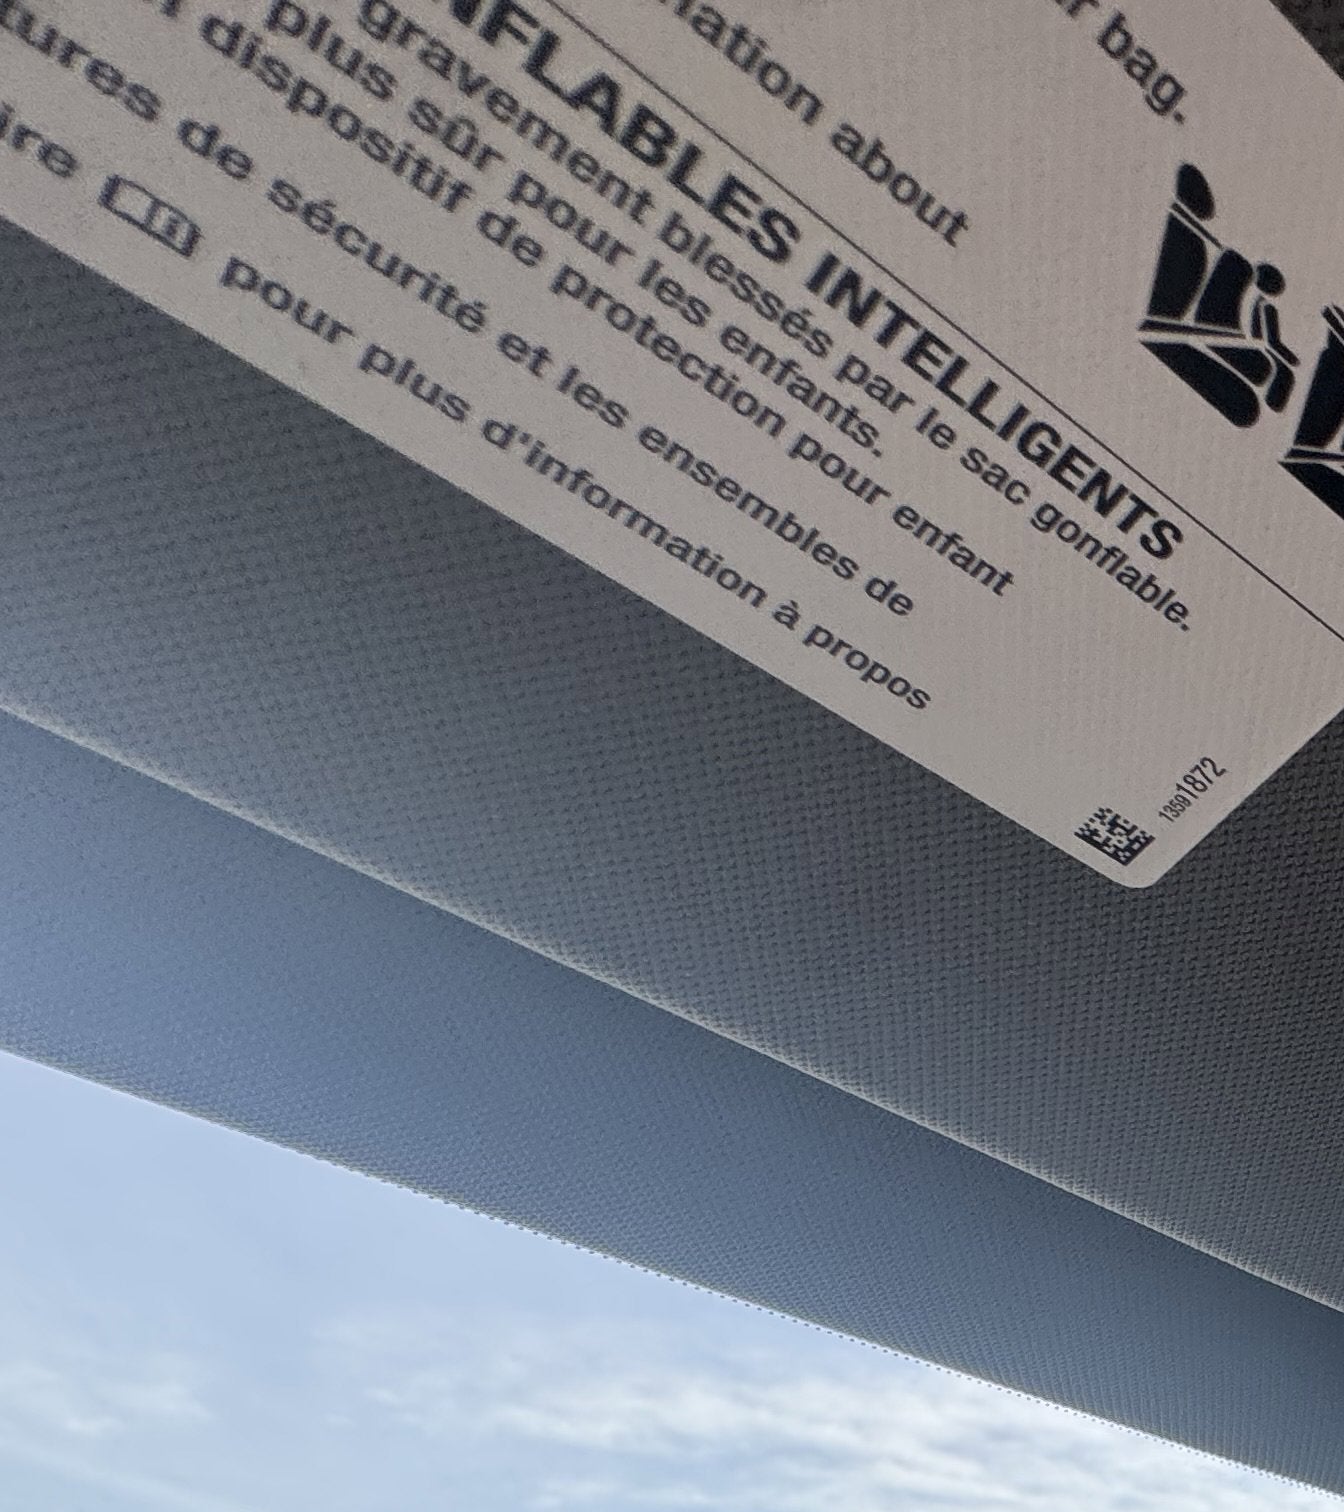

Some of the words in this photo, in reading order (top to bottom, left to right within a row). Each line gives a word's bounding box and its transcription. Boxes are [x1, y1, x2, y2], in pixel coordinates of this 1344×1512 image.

[264, 0, 399, 103] plus
[408, 99, 506, 173] sûr
[506, 171, 636, 266] pour
[637, 259, 713, 327] les
[719, 325, 883, 459] enfants.
[660, 0, 825, 127] ation
[829, 123, 970, 248] about
[1096, 11, 1187, 125] bag.
[178, 119, 254, 181] de
[267, 179, 488, 334] sécurité
[497, 333, 553, 379] et
[557, 365, 631, 429] les
[638, 426, 860, 581] ensembles
[864, 577, 915, 617] de
[200, 14, 475, 213] dispositif
[477, 211, 547, 268] de
[549, 262, 787, 440] protection
[788, 433, 892, 506] pour
[892, 505, 1014, 597] enfant
[220, 257, 356, 345] pour
[358, 344, 472, 424] plus
[481, 420, 768, 608] d'information
[772, 600, 802, 631] à
[803, 625, 932, 710] propos
[357, 0, 656, 227] gravement
[657, 211, 835, 360] blessés
[833, 354, 917, 415] par
[915, 407, 958, 451] le
[960, 447, 1031, 506] sac
[1030, 502, 1190, 632] gonflable.
[804, 251, 1185, 561] INTELLIGENTS
